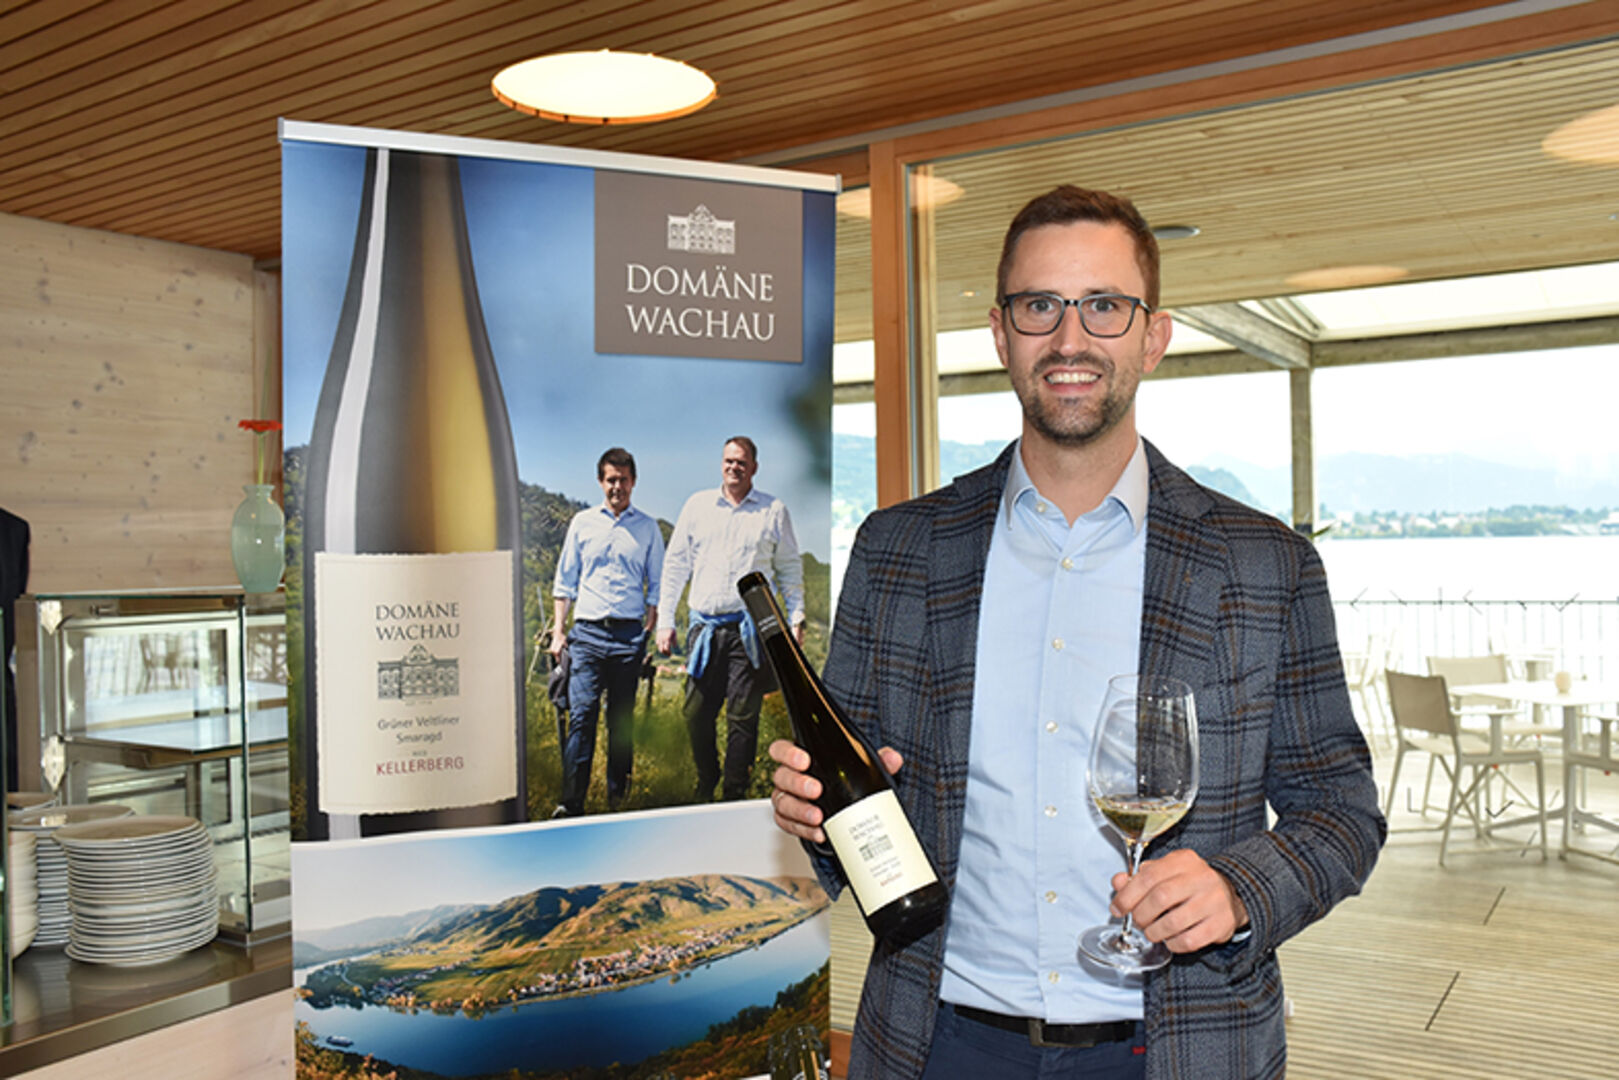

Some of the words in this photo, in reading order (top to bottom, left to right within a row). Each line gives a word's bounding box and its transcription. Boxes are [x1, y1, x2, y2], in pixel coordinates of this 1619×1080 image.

[627, 264, 774, 301] DOMÄNE
[625, 304, 775, 341] WACHAU
[375, 600, 460, 621] DOMÄNE
[375, 623, 460, 641] WACHAU
[377, 718, 413, 730] Grüner
[395, 731, 443, 744] Smaragd
[375, 756, 465, 775] KELLERBERG
